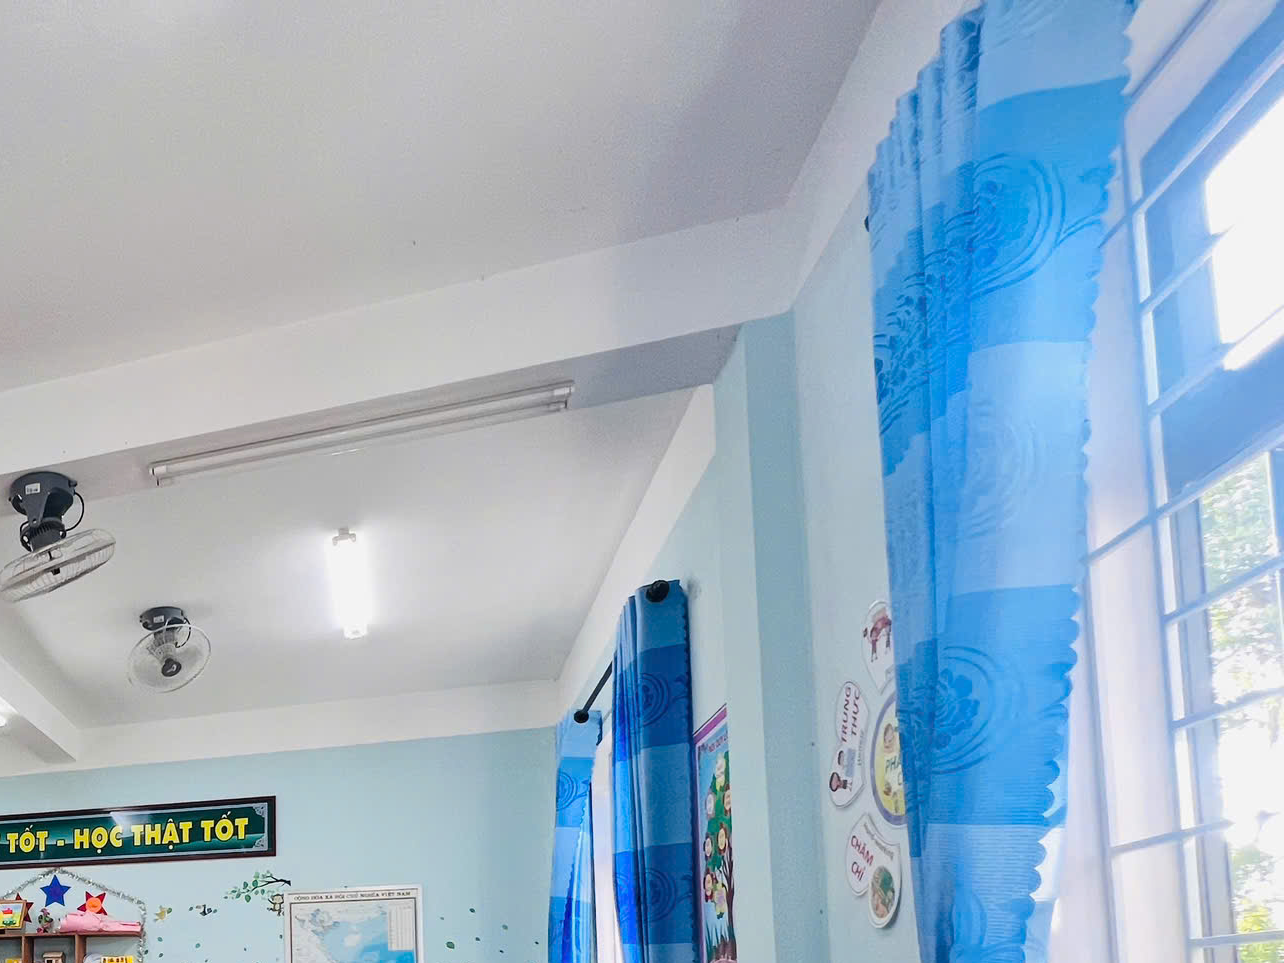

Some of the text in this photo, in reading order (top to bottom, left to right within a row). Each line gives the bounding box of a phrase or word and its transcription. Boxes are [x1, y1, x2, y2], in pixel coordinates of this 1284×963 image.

[841, 686, 851, 742] TRUNG
[7, 824, 48, 853] TỐT
[74, 826, 124, 854] HỌC
[131, 818, 193, 850] THẬT
[201, 811, 249, 842] TỐT
